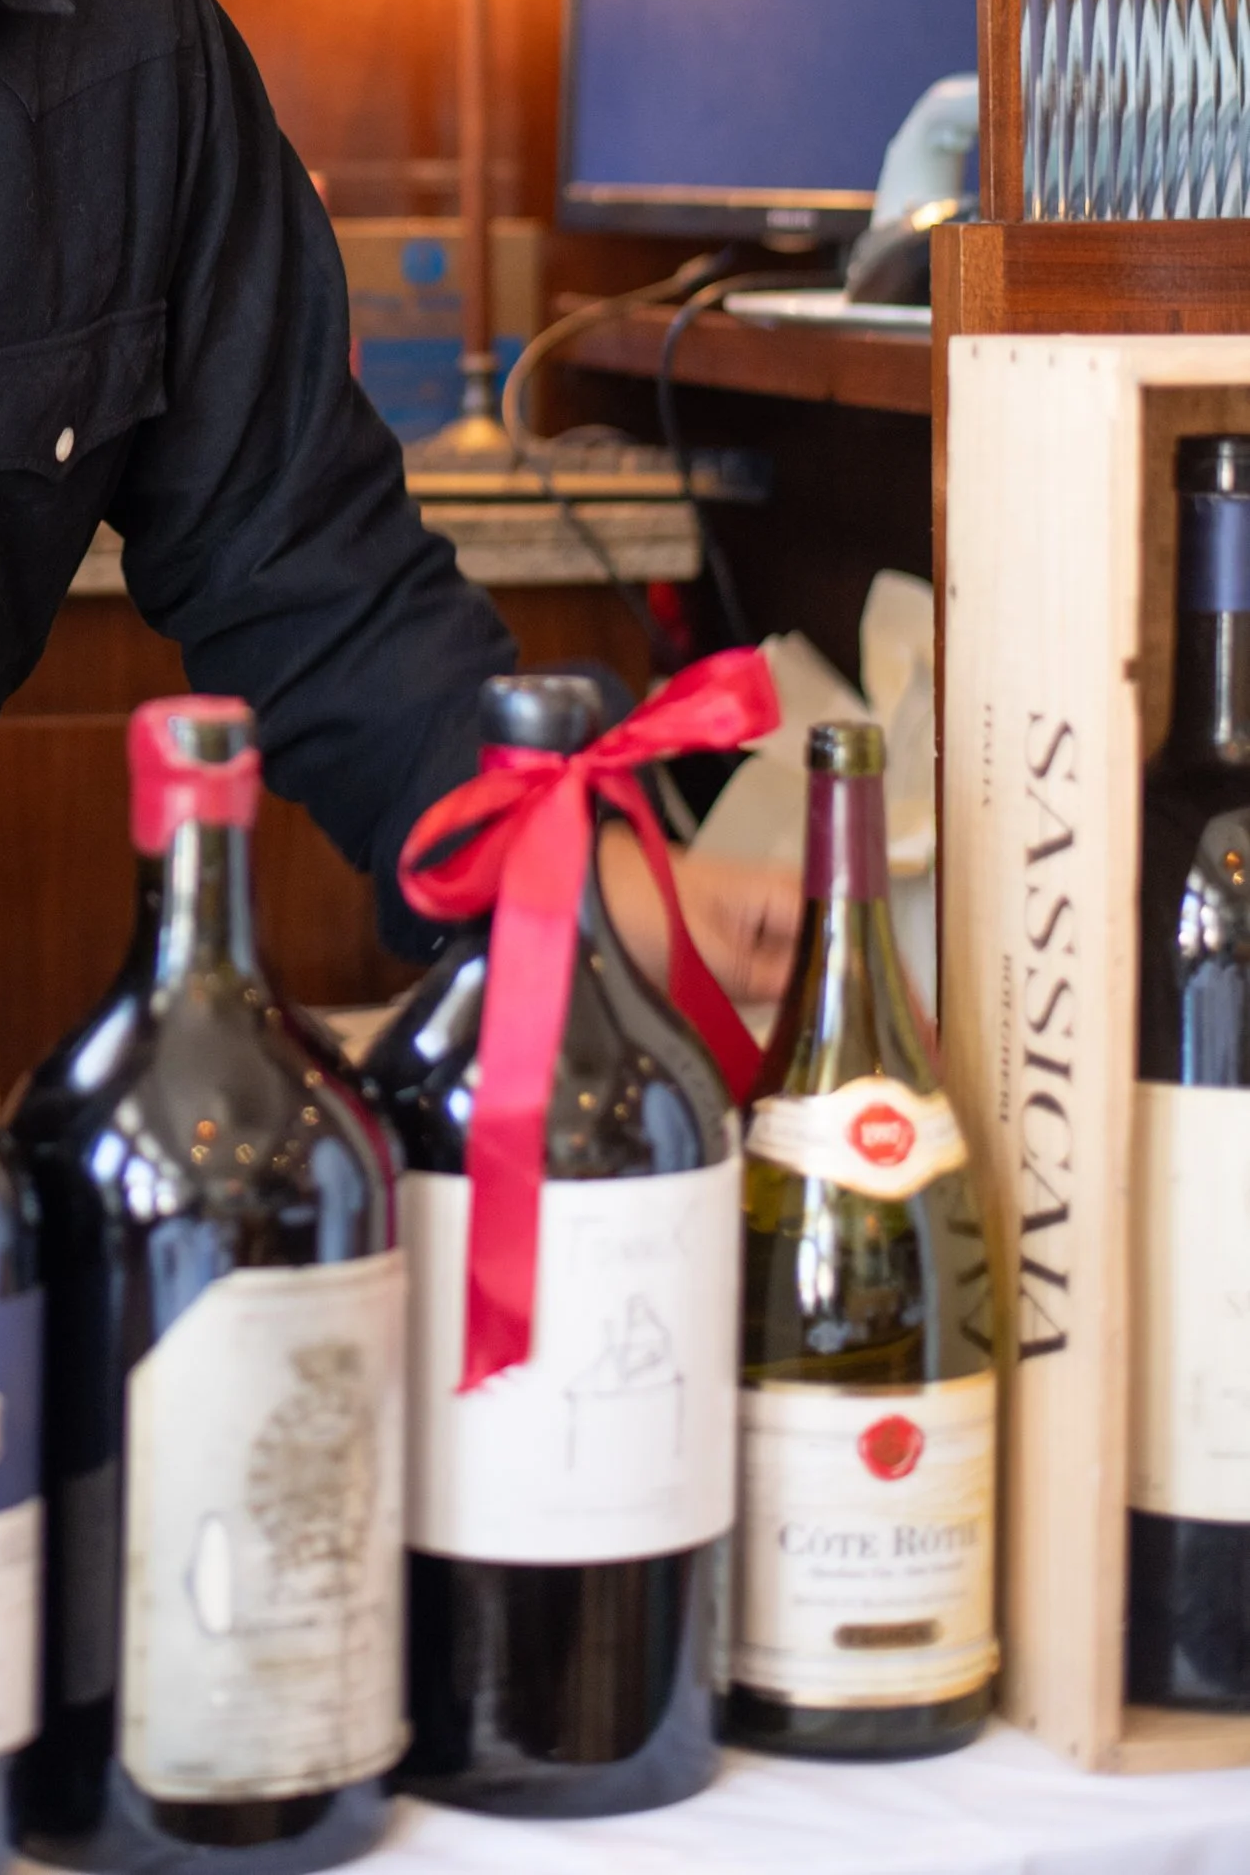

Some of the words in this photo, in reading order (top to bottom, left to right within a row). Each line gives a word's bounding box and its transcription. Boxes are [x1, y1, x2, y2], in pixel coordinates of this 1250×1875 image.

[981, 703, 993, 809] ITALIA
[998, 953, 1013, 1124] BOLGHERI
[1016, 710, 1080, 1362] SASSICAIA
